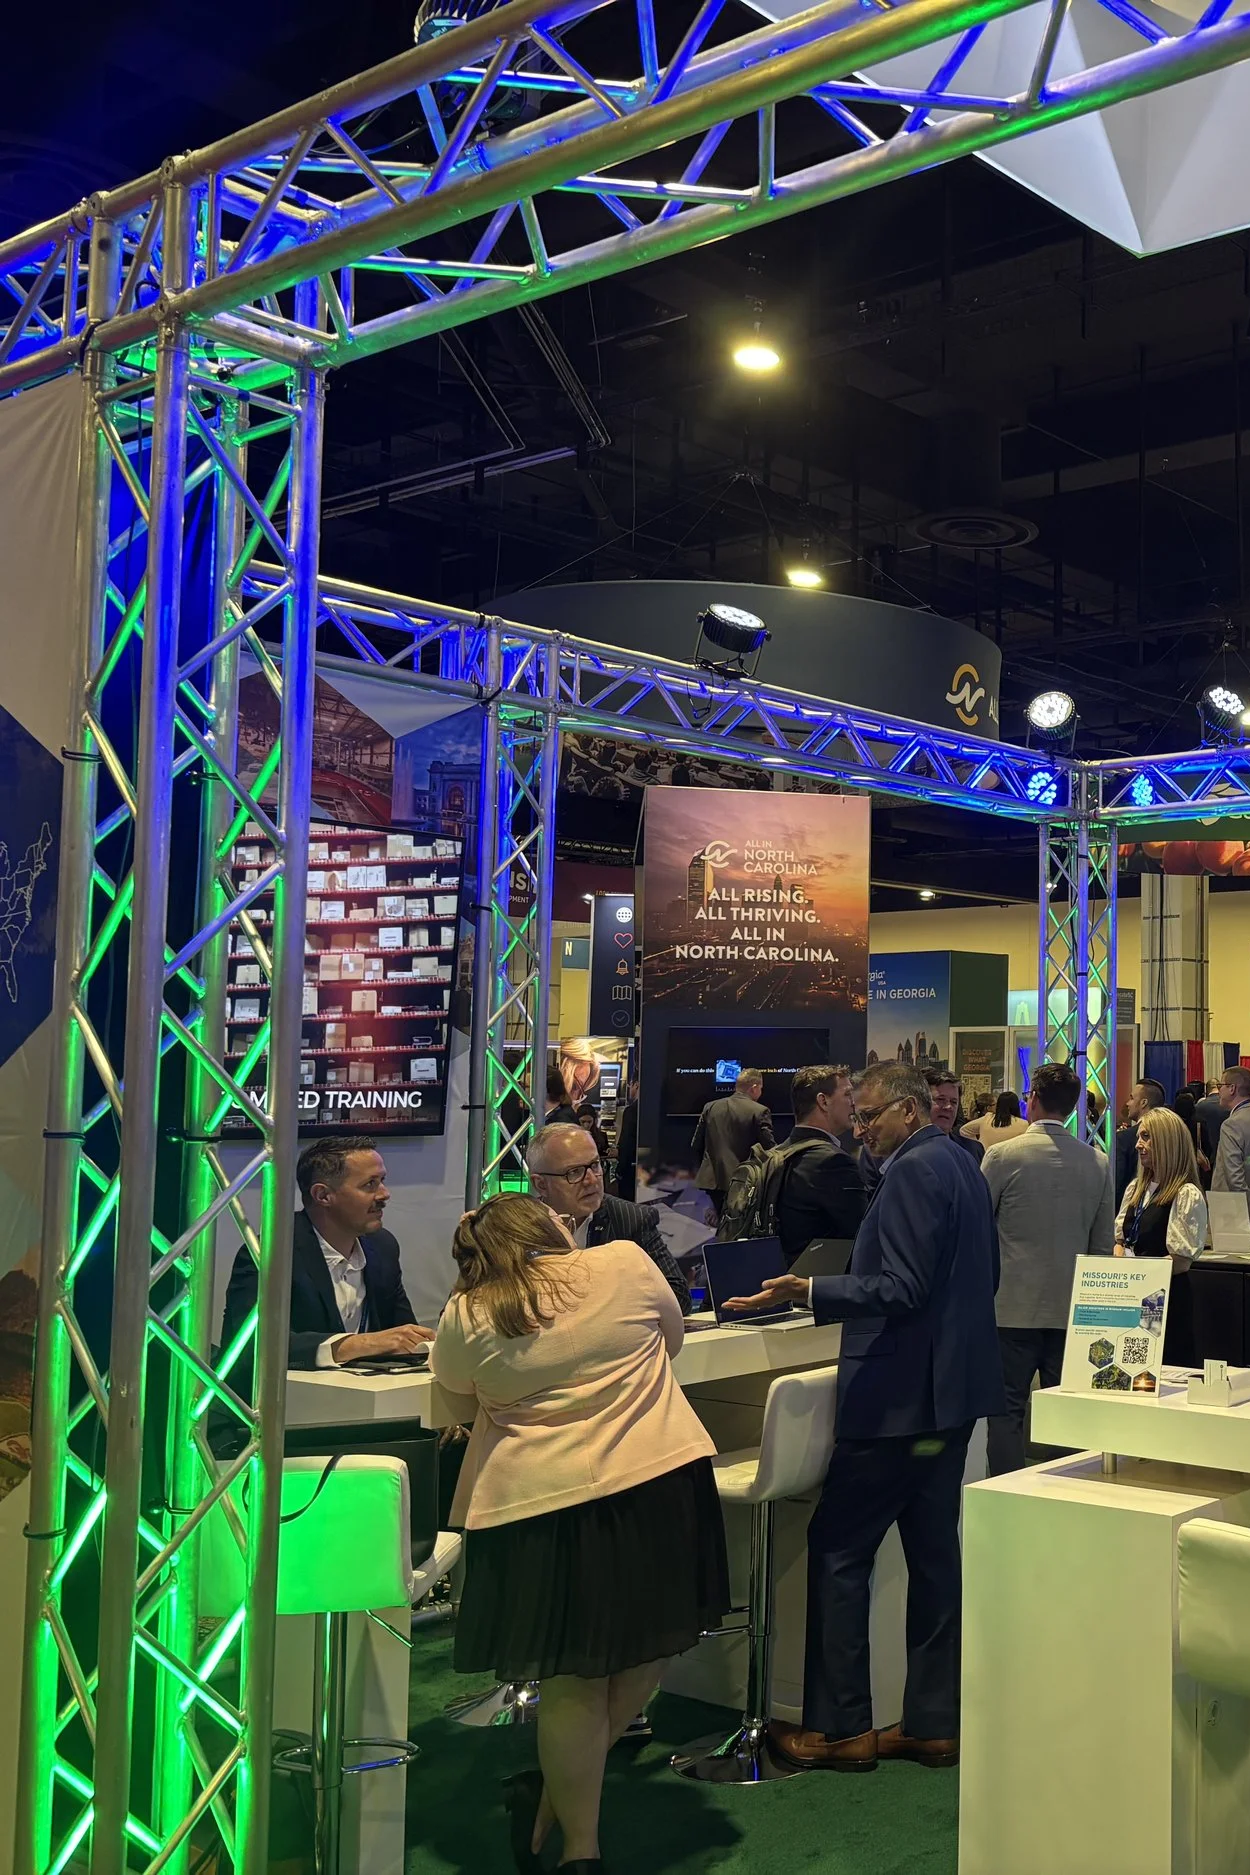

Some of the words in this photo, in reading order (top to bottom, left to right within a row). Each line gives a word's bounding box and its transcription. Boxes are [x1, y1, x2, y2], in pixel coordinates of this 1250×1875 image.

[745, 840, 760, 848] ALL
[762, 841, 772, 849] IN
[744, 849, 793, 862] NORTH
[744, 862, 817, 876] CAROLINA
[708, 888, 739, 901] ALL
[744, 888, 809, 904] RISING.
[695, 907, 726, 921] ALL
[730, 908, 821, 924] THRIVING.
[730, 927, 761, 941] ALL
[767, 928, 785, 942] IN
[675, 945, 739, 960] NORTH
[744, 947, 839, 963] CAROLINA.
[877, 990, 886, 999] IN
[889, 988, 937, 999] GEORGIA
[324, 1090, 422, 1108] TRAINING
[1082, 1271, 1128, 1281] MISSOURI'S
[1129, 1273, 1146, 1281] KEY
[1081, 1280, 1129, 1289] INDUSTRIES
